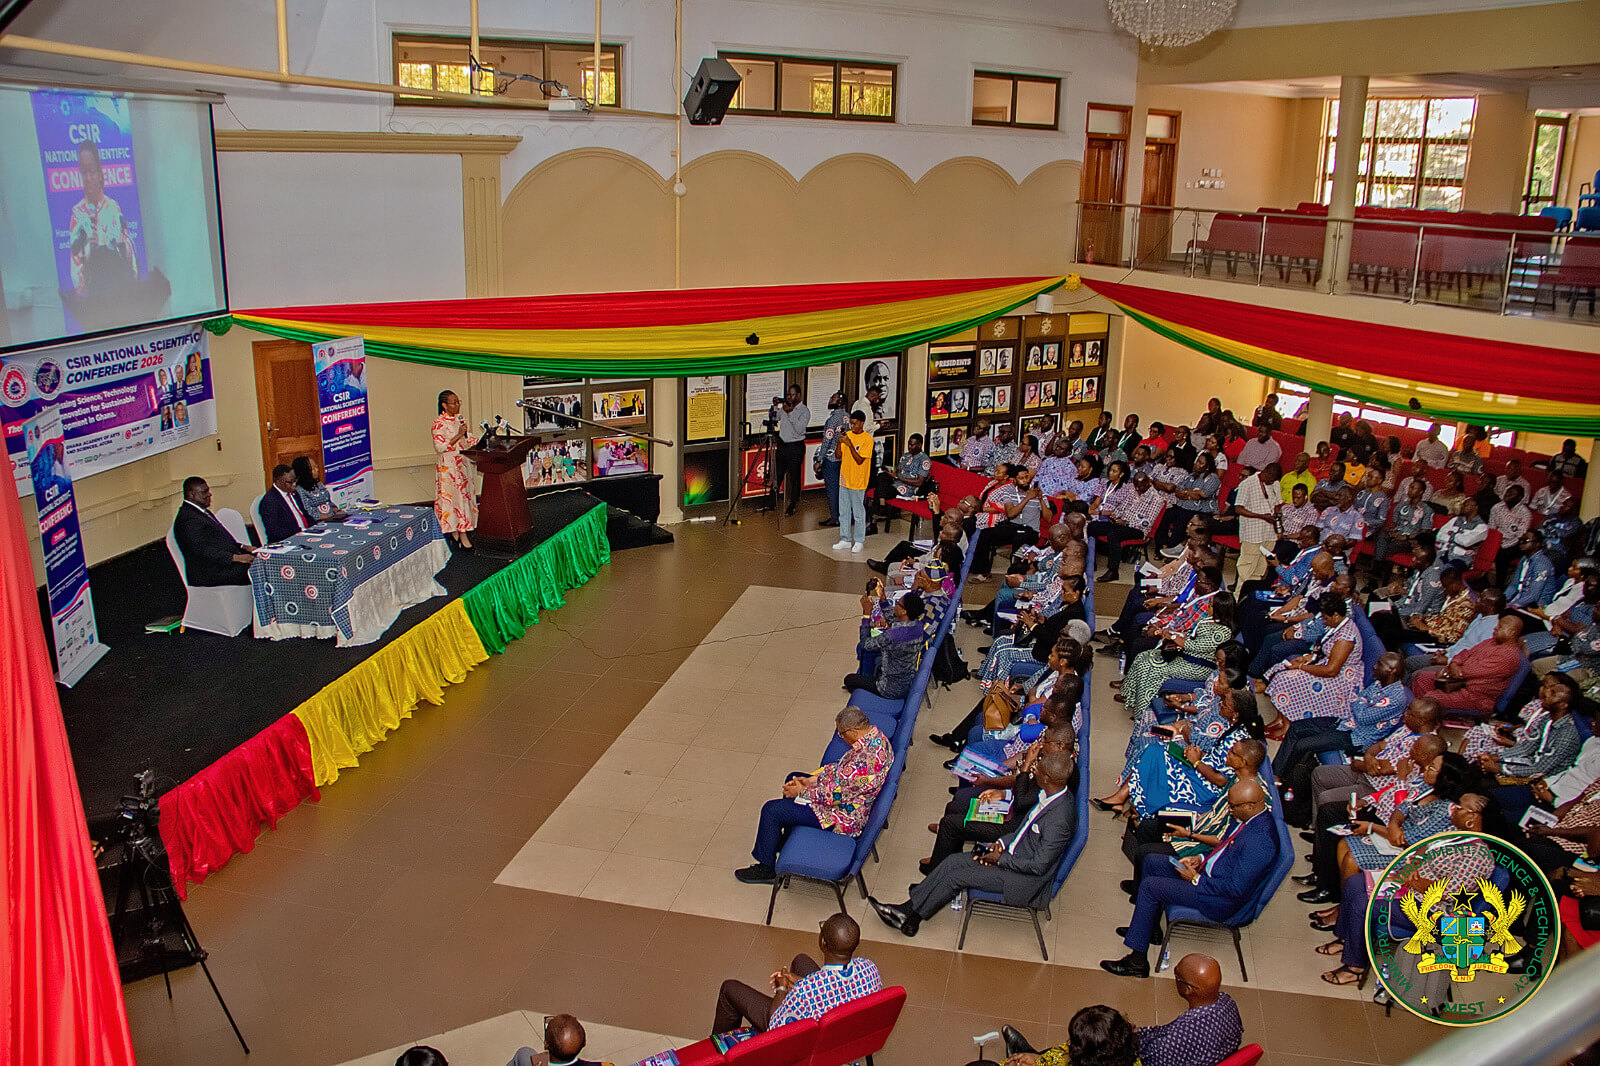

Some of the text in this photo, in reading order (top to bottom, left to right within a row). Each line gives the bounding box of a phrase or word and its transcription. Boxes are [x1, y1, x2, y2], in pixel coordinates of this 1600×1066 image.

[69, 124, 101, 144] CSIR
[45, 150, 79, 163] NATION
[51, 167, 132, 190] CONENCE
[66, 332, 201, 369] CSIR NATIONAL SCIENTIFIC
[66, 353, 163, 385] CONFERENCE 2026
[935, 358, 971, 367] PRESIDENTS
[77, 394, 103, 405] Science,
[103, 385, 138, 398] Technology
[333, 391, 350, 402] CSIR
[91, 404, 101, 412] for
[101, 396, 136, 410] Sustainable
[320, 403, 342, 413] NATIONAL
[322, 406, 365, 423] CONFERENCE
